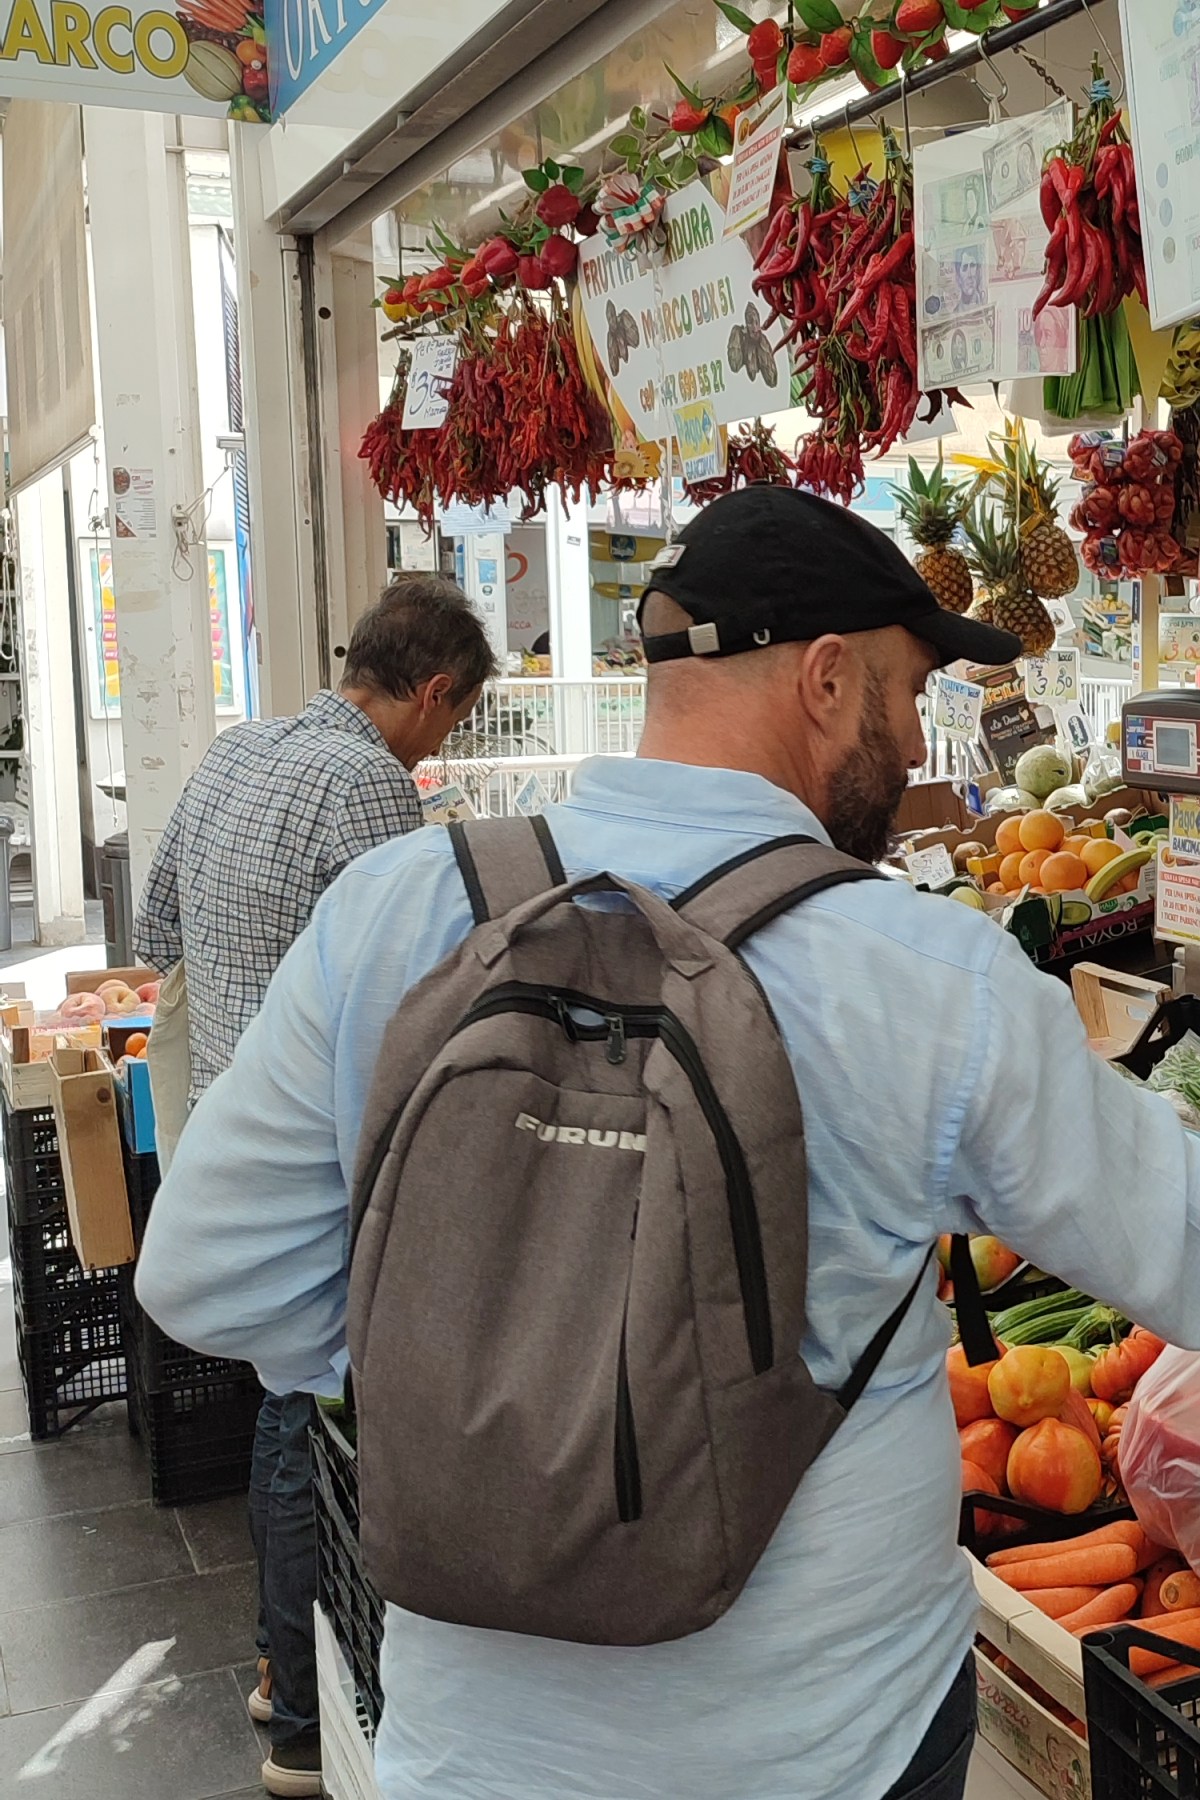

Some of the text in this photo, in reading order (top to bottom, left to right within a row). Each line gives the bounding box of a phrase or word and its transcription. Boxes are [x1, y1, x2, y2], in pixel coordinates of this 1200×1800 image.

[582, 202, 715, 299] FRUTTA RDURA
[691, 285, 719, 326] BOX
[717, 274, 735, 318] 51
[1172, 803, 1196, 836] Pago
